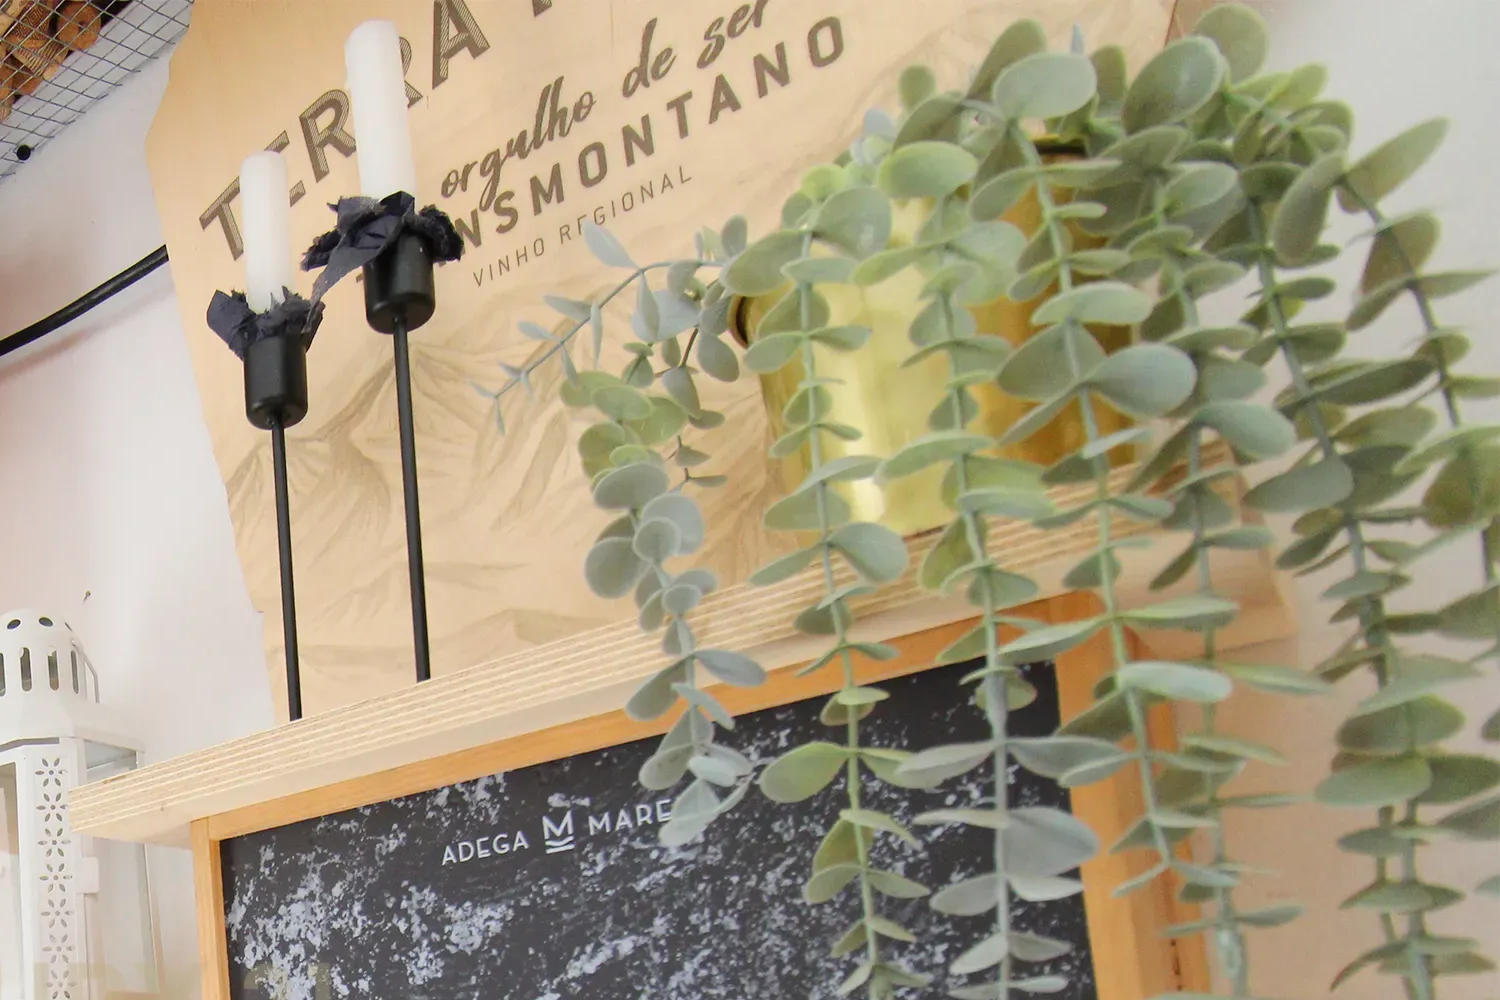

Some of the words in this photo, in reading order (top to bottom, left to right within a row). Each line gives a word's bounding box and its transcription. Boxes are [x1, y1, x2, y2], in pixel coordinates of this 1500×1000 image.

[199, 0, 491, 260] TRA
[356, 16, 845, 284] NSMONTANO
[441, 76, 596, 211] orgulho
[622, 17, 677, 98] de
[697, 0, 770, 70] ser
[473, 238, 545, 287] VINHO
[559, 165, 692, 243] REGIONAL
[442, 831, 529, 866] ADEGA
[588, 800, 672, 836] MARE
